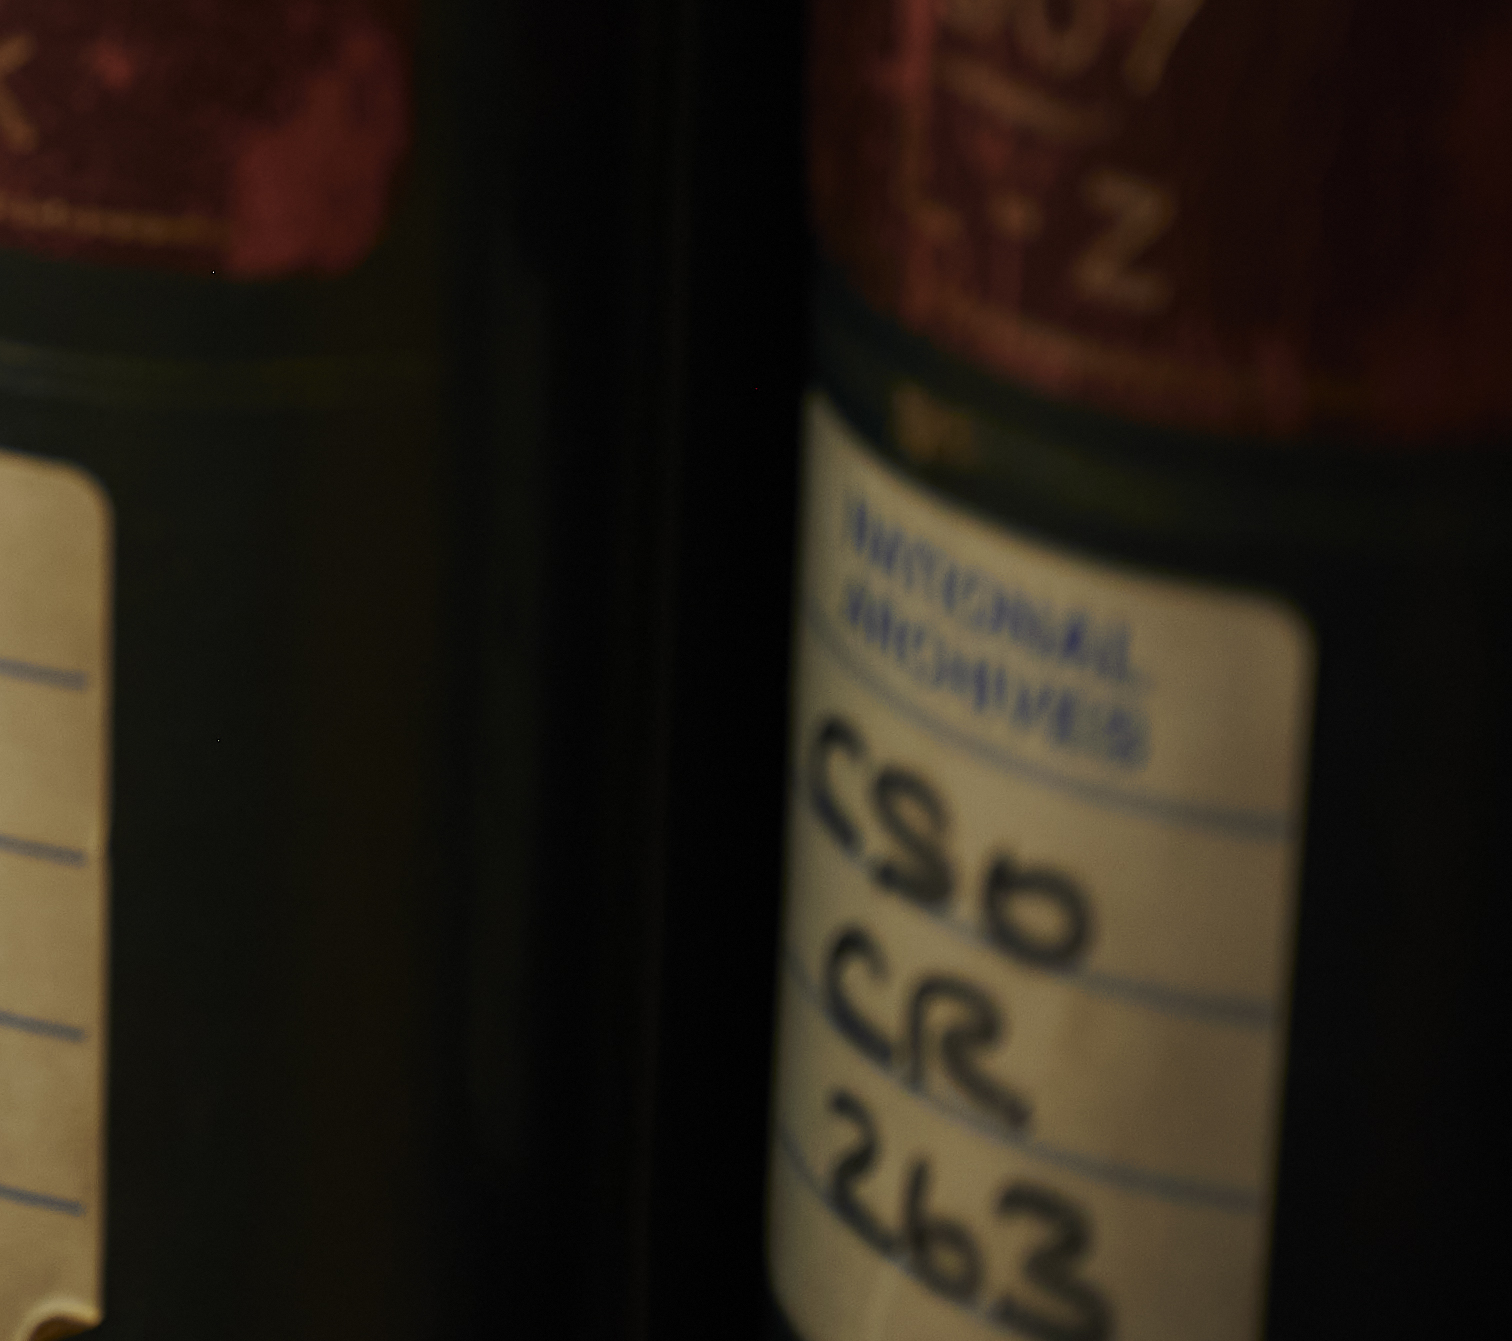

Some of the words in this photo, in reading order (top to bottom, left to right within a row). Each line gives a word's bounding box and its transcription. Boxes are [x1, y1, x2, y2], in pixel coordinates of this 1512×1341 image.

[1069, 164, 1180, 315] Z
[820, 924, 1036, 1135] CR
[824, 1084, 1119, 1341] 263
